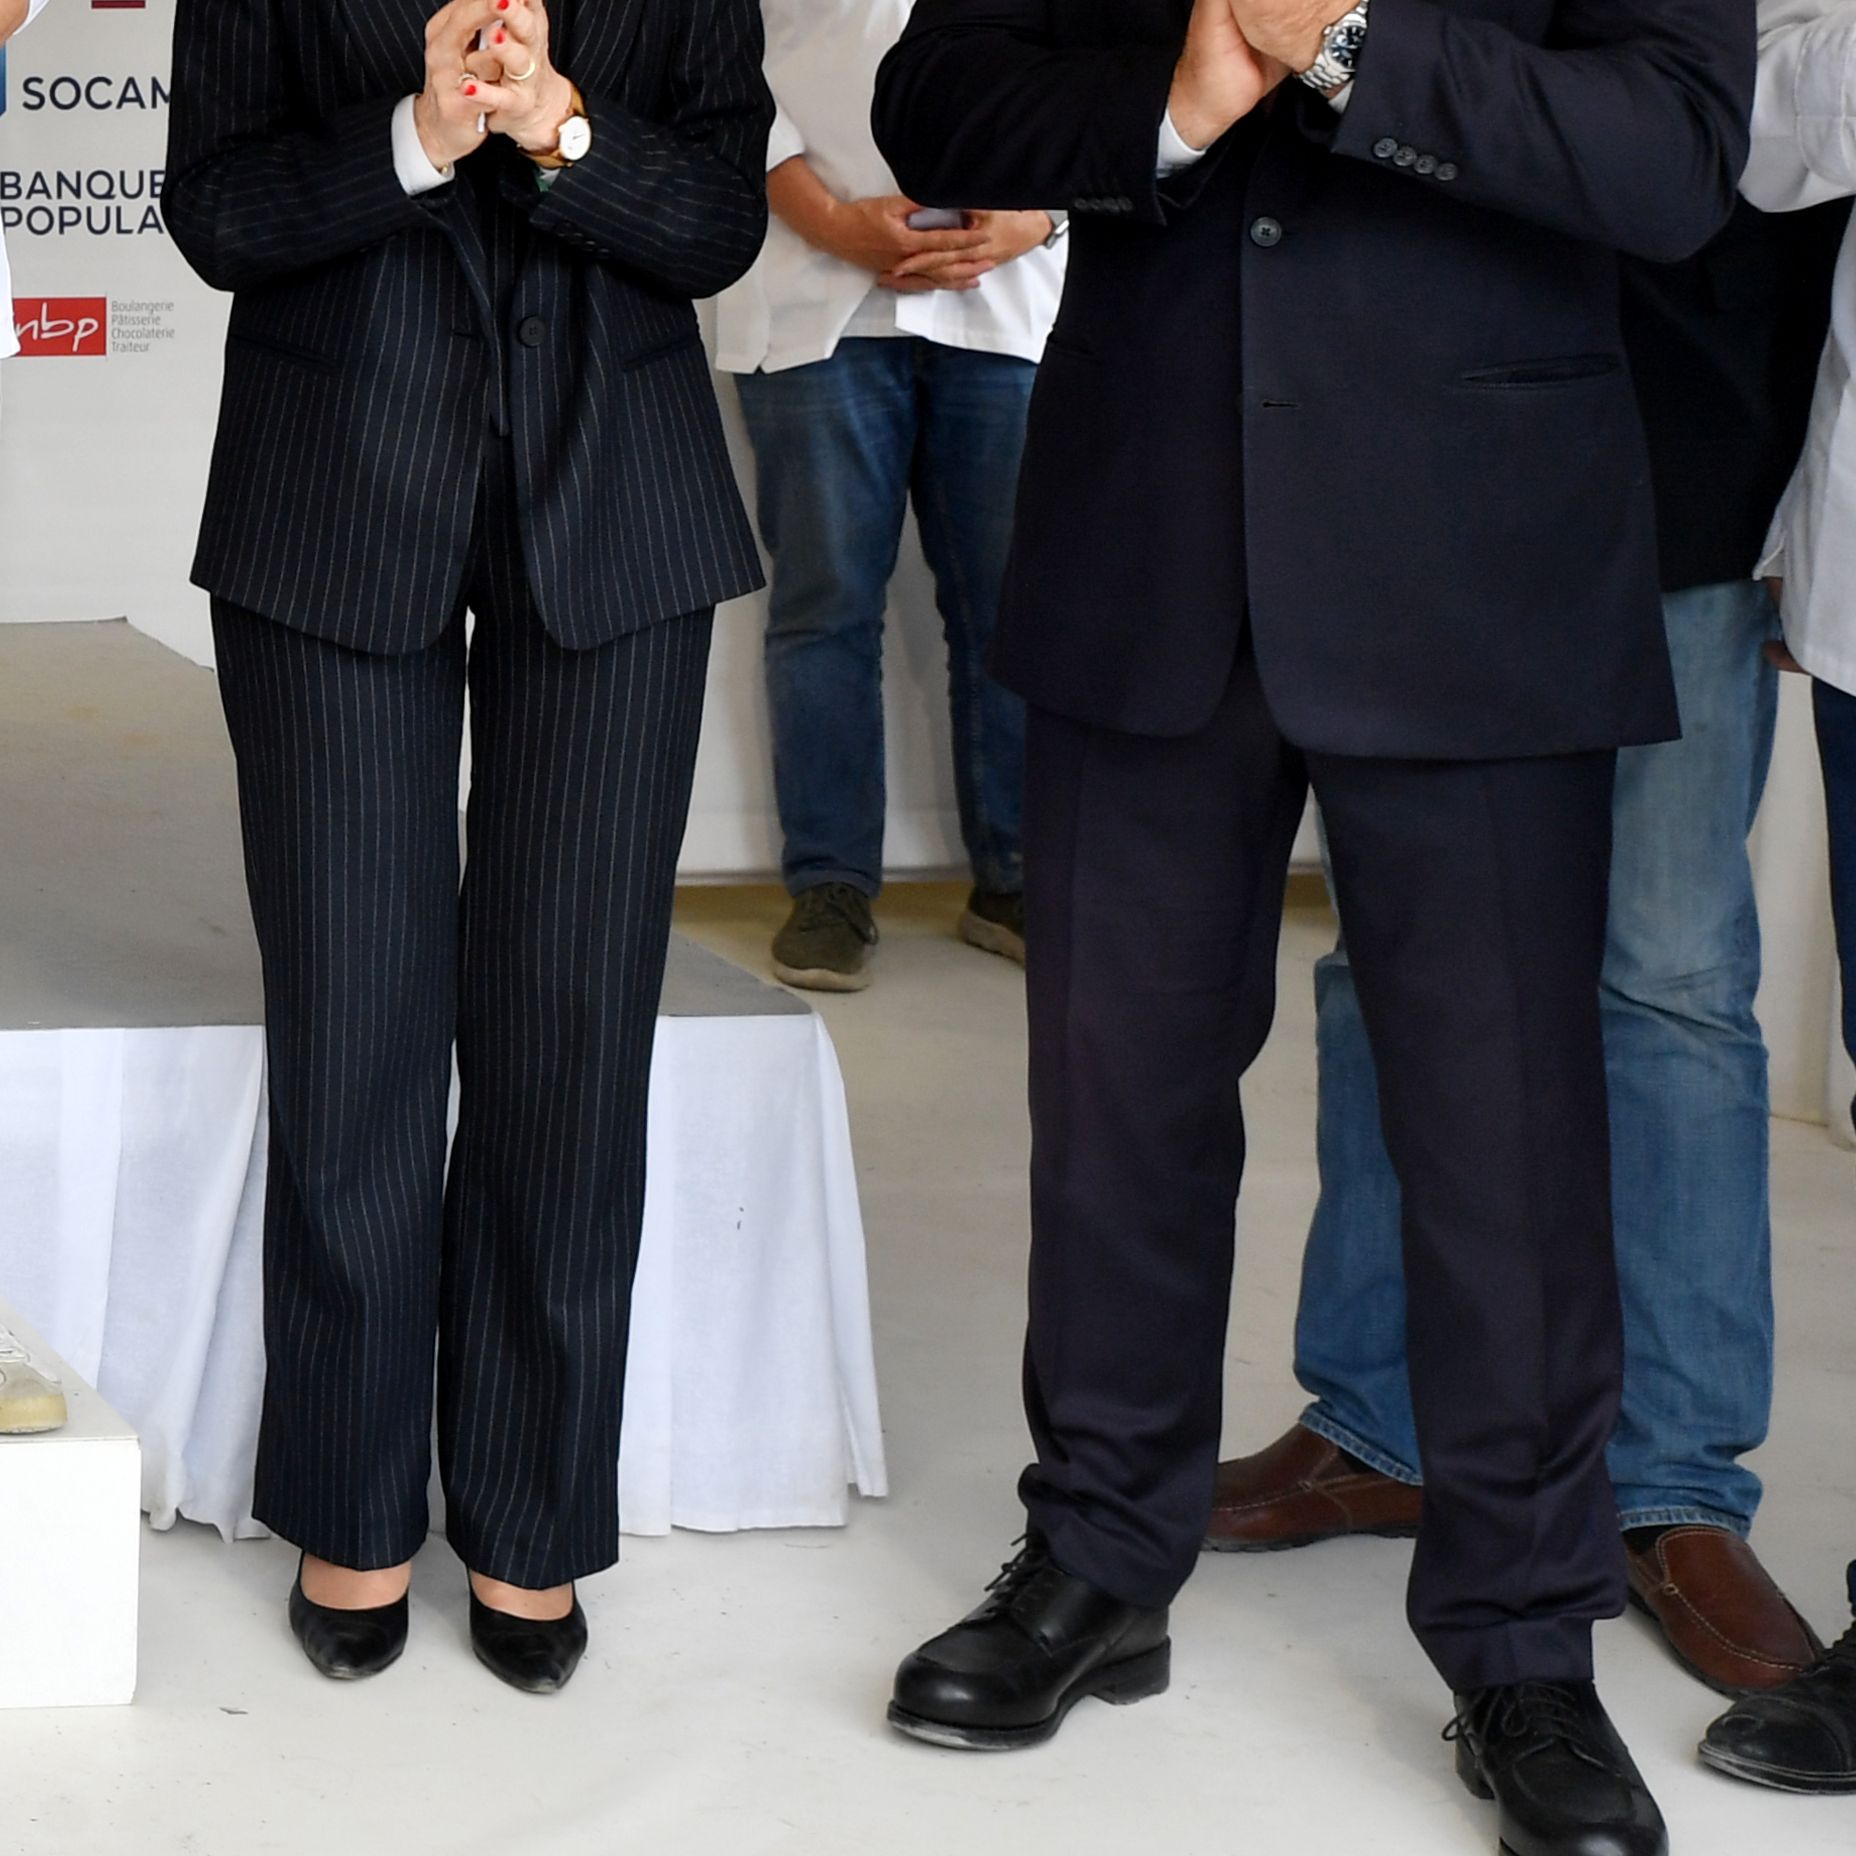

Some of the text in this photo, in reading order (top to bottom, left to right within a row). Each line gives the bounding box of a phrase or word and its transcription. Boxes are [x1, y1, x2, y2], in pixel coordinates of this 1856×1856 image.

[22, 76, 171, 110] SOCAM
[2, 206, 164, 235] POPULA
[111, 300, 175, 315] Boulangerie
[16, 302, 99, 352] nbp
[111, 313, 161, 326] Pâtisserie
[111, 327, 175, 339] Chocolaterie
[111, 341, 150, 353] Traiteur
